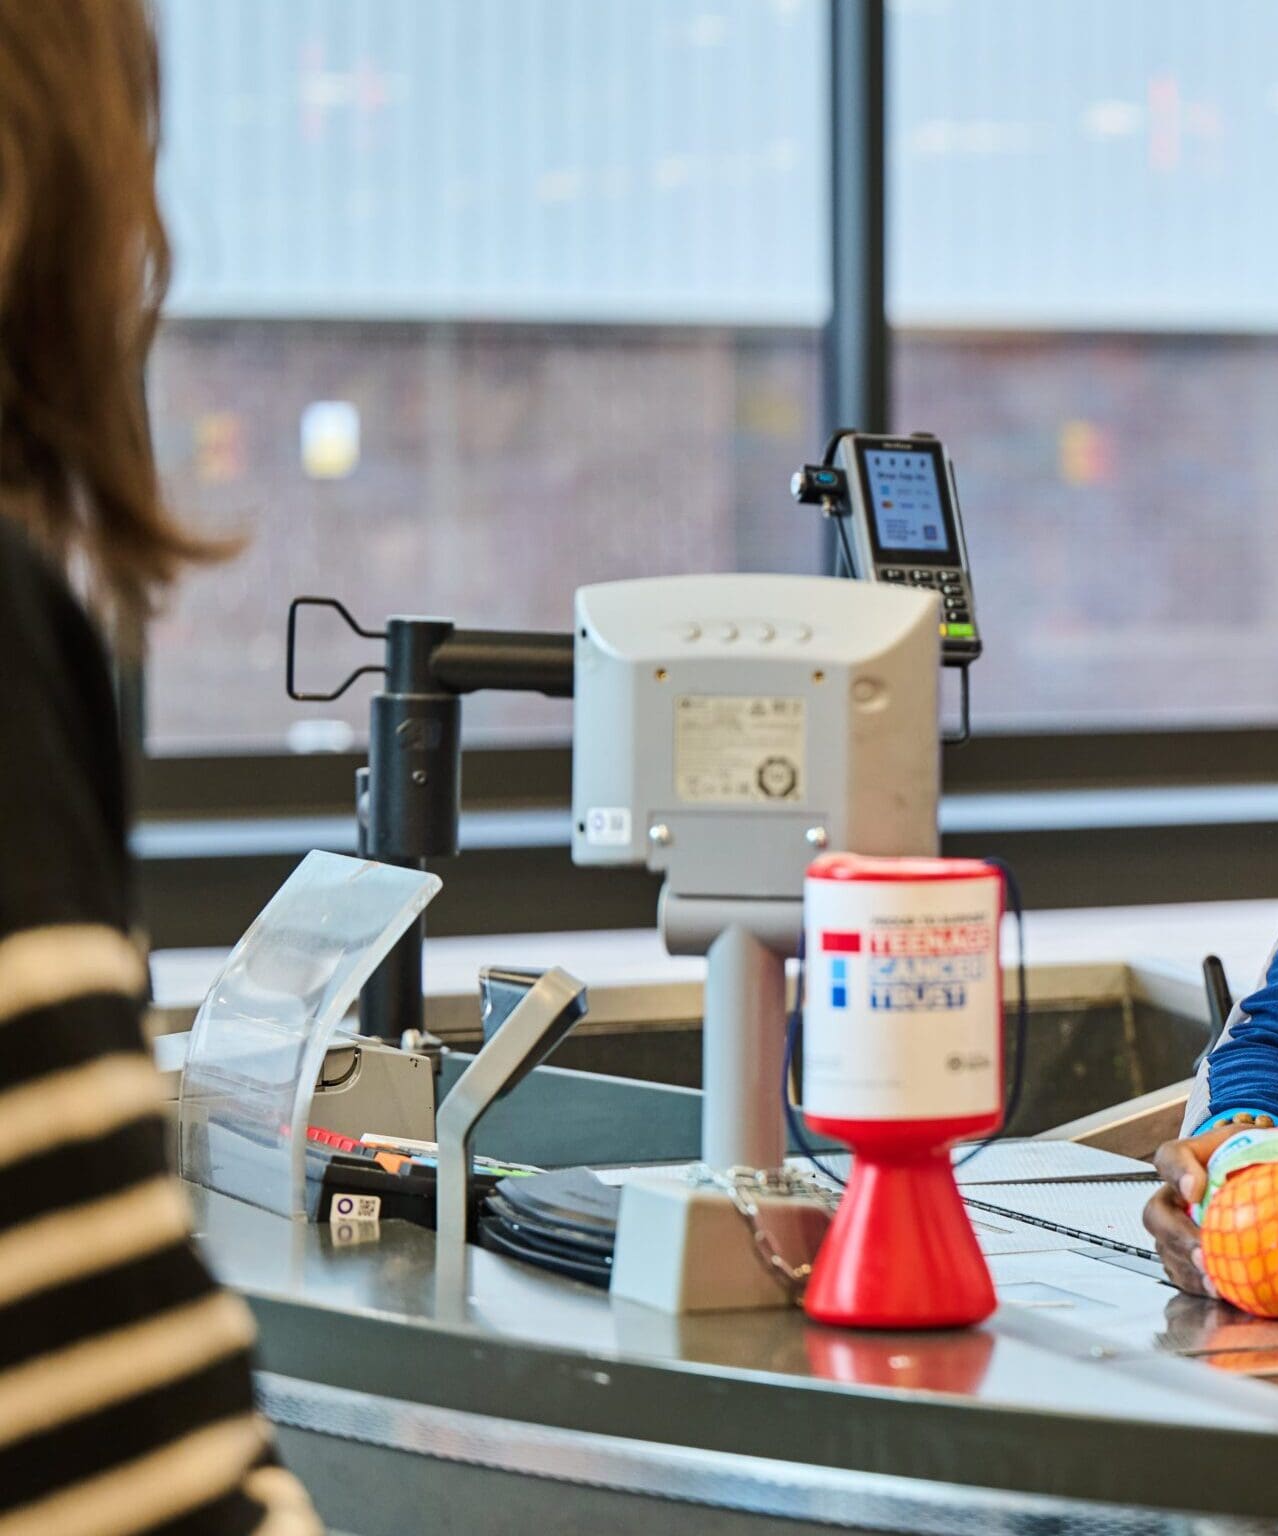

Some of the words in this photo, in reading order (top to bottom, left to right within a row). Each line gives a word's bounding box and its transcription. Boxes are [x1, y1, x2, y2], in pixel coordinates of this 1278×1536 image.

[869, 926, 992, 957] TEENAGE
[869, 955, 984, 983] CANCER
[869, 980, 967, 1010] TRUST
